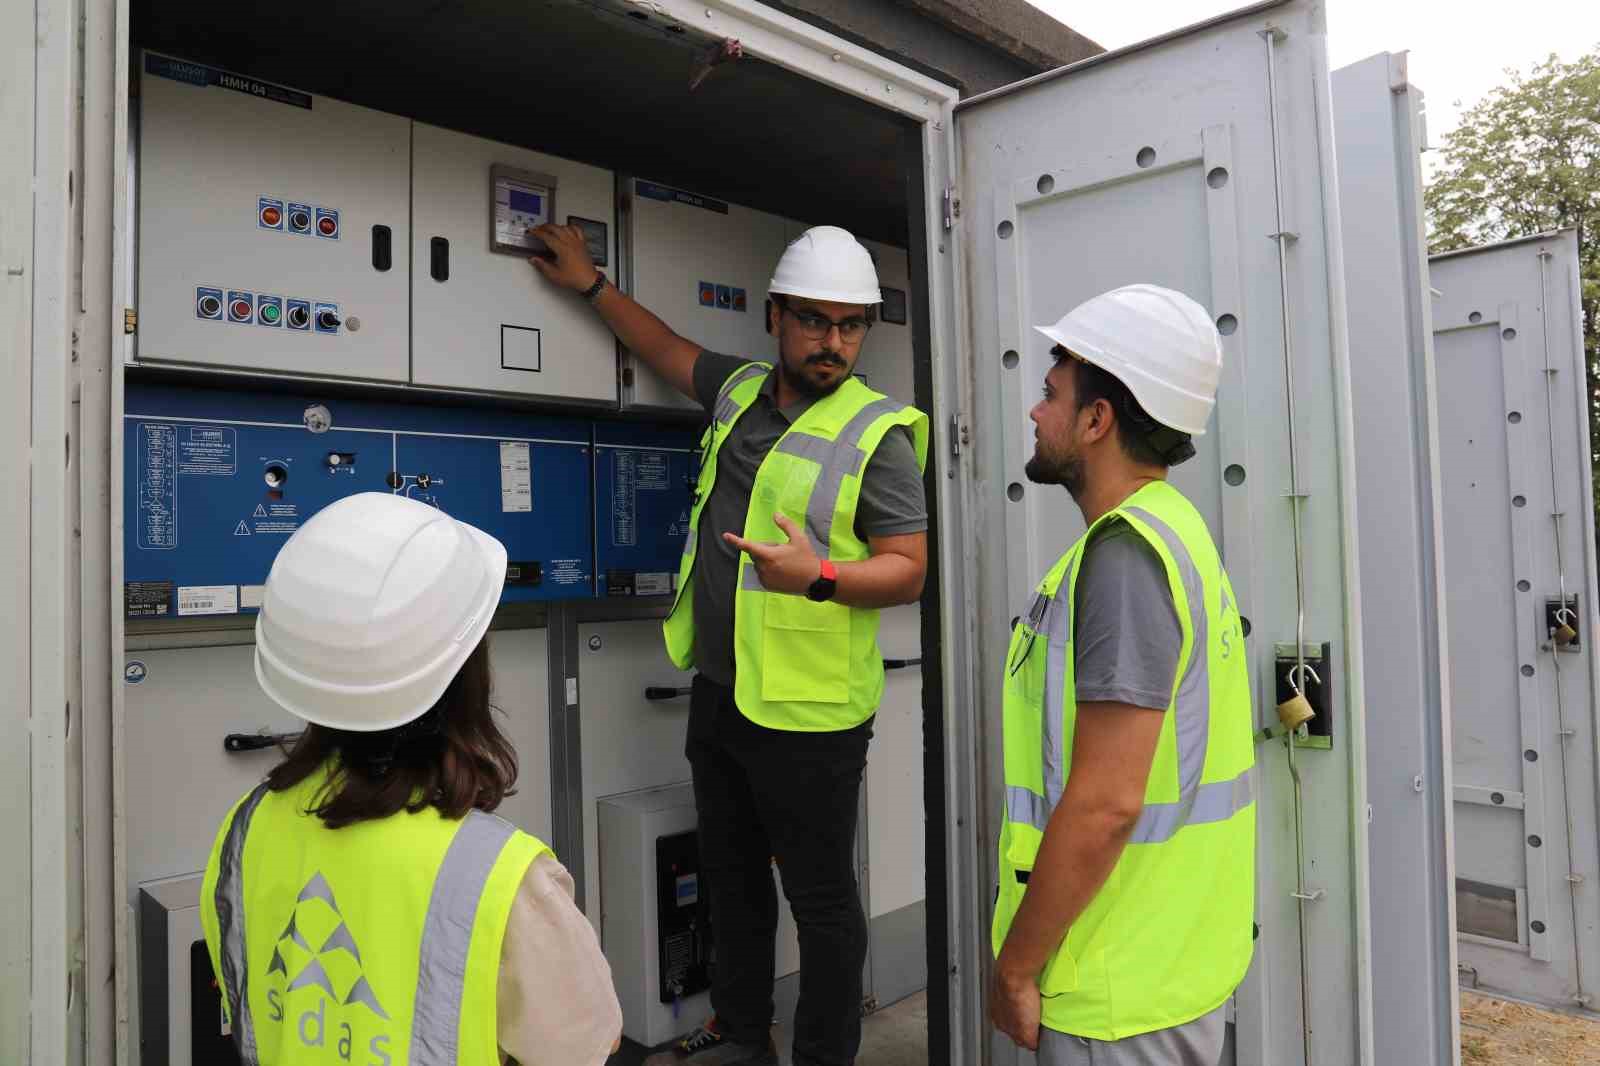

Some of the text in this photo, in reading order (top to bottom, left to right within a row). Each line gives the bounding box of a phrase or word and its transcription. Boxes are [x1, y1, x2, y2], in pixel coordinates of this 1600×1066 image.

[220, 75, 250, 91] HMH
[251, 82, 266, 96] 04
[267, 989, 391, 1066] sdas
